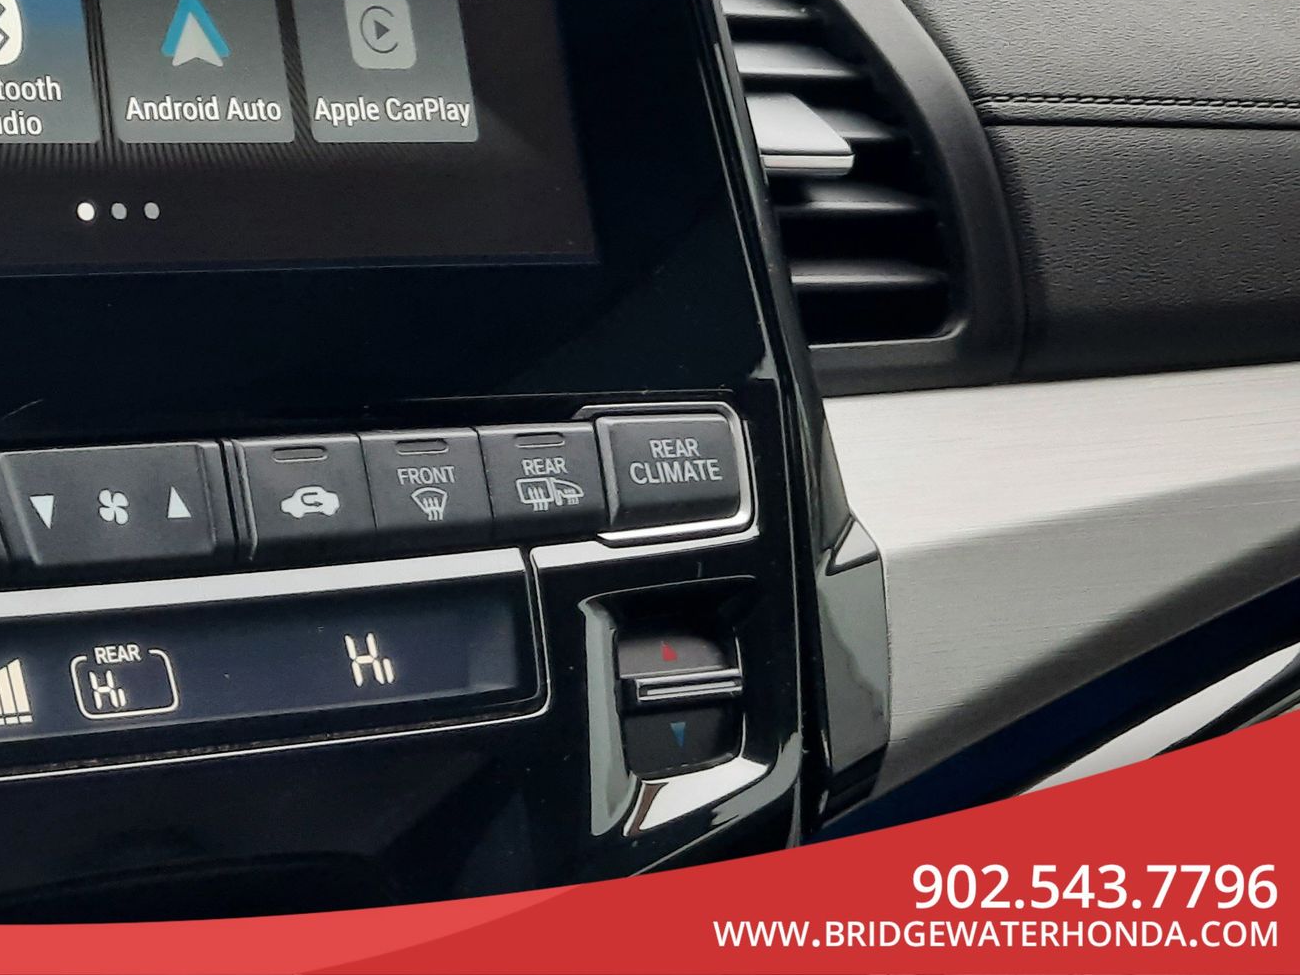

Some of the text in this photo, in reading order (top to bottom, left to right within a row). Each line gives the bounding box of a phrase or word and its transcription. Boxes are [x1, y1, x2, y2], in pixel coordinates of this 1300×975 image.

[126, 95, 282, 121] Android Auto
[315, 96, 470, 127] Apple CarPlay
[649, 438, 701, 459] REAR
[397, 465, 455, 485] FRONT
[521, 457, 569, 476] REAR
[629, 455, 723, 484] CLIMATE
[94, 644, 142, 665] REAR
